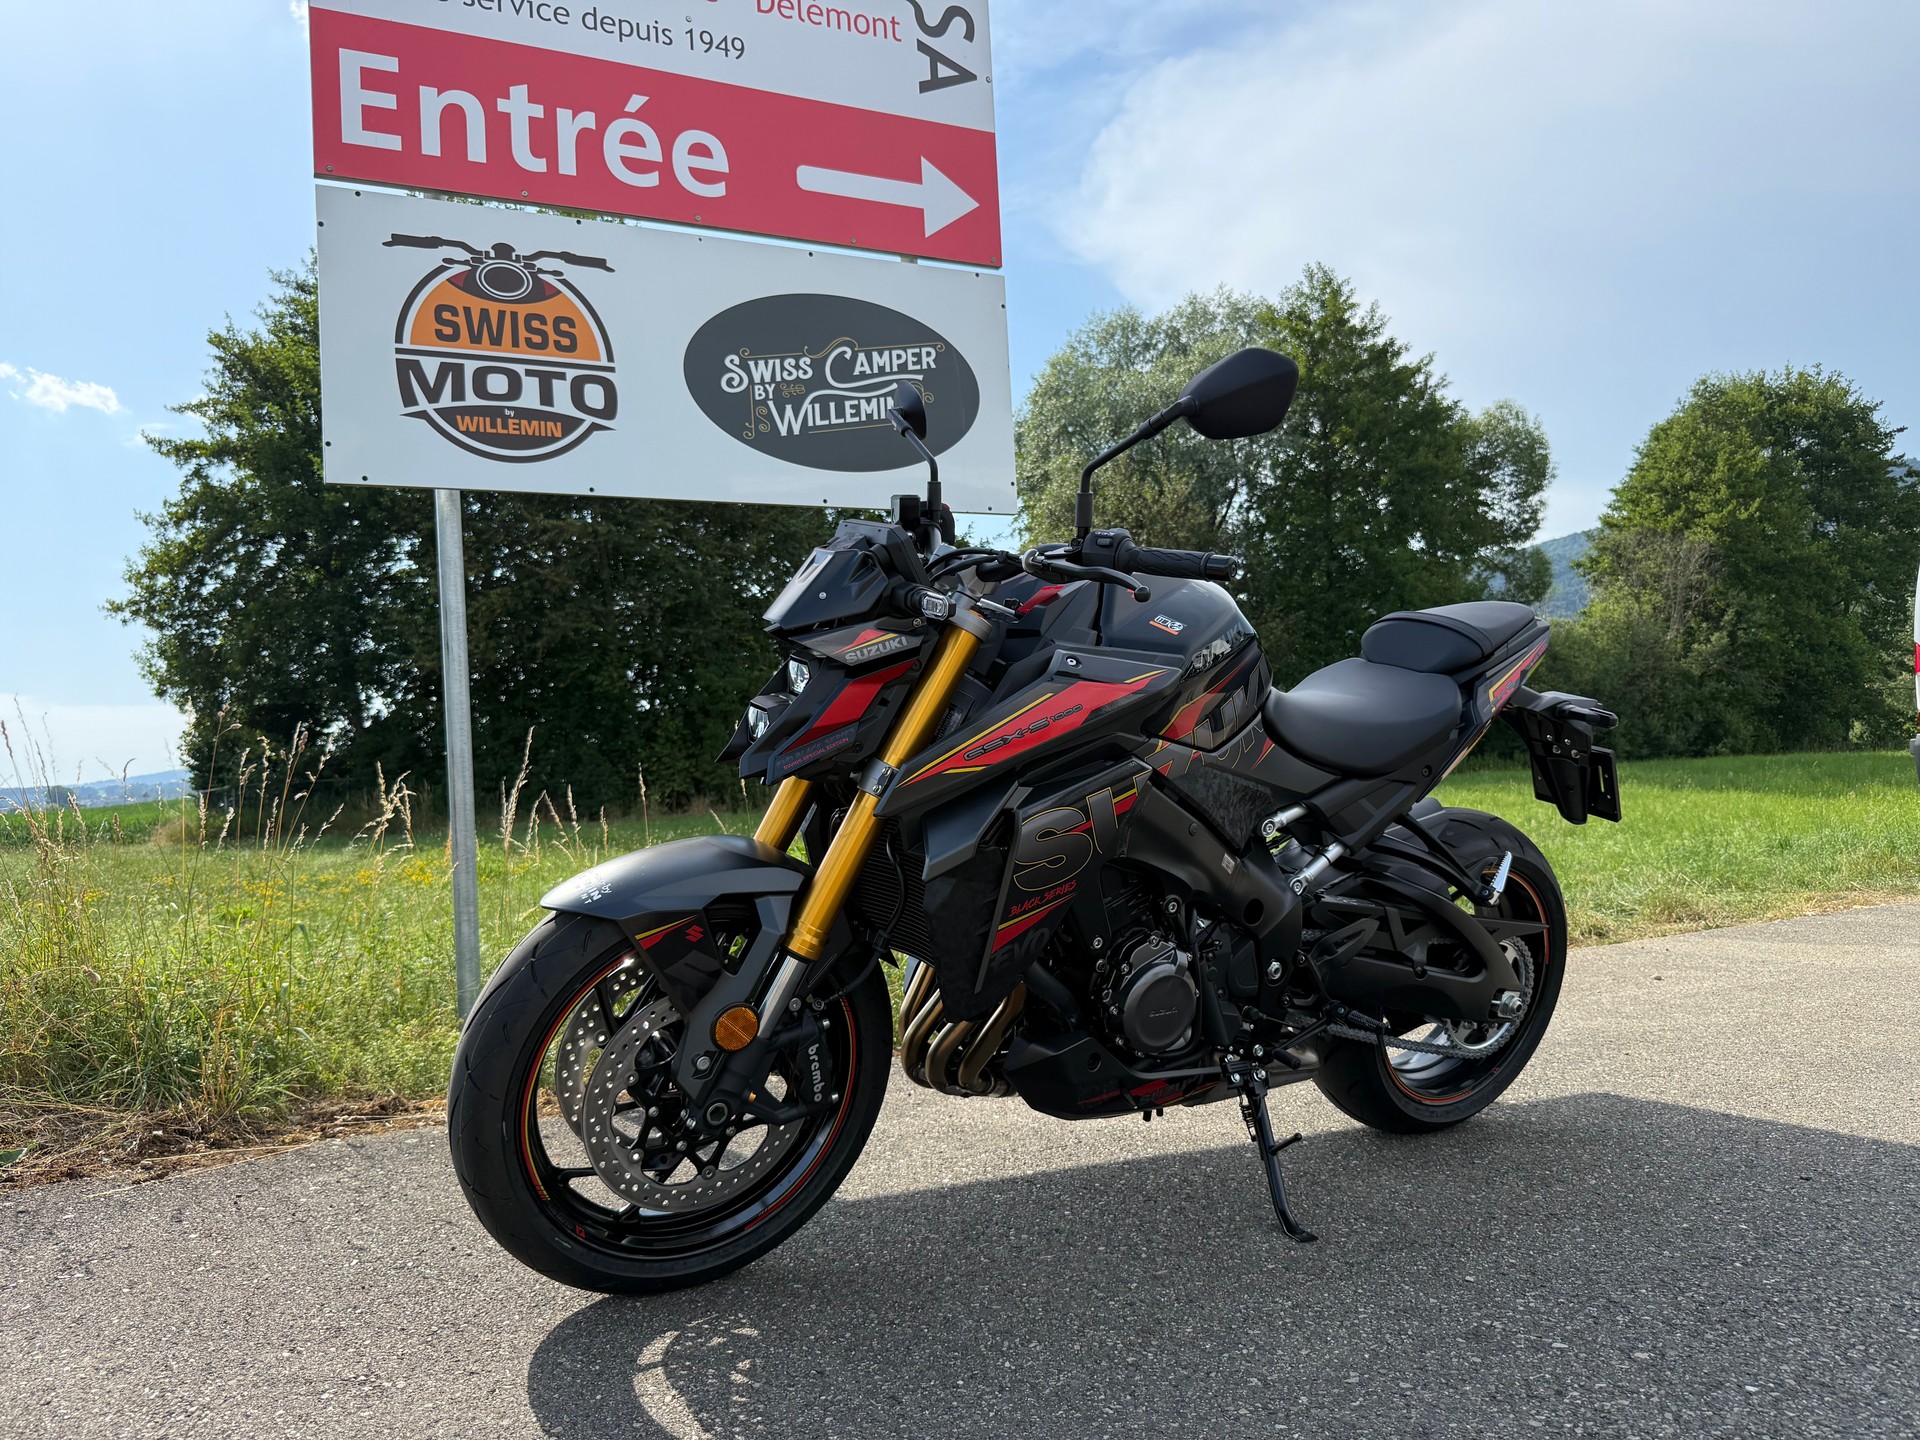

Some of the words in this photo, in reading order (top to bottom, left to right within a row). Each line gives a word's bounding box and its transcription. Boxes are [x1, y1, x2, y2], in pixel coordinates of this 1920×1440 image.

[581, 7, 673, 46] depuis
[685, 28, 745, 60] 1949
[338, 47, 730, 198] Entrée
[433, 303, 578, 354] SWISS
[395, 357, 619, 421] MOTO
[505, 408, 515, 418] by
[456, 415, 563, 438] WILLEMIN
[844, 636, 908, 663] SUZUKI
[963, 717, 1050, 761] GSX-S
[1050, 704, 1084, 722] 1000
[1009, 896, 1042, 917] BLACK
[1042, 879, 1077, 904] SERIES
[807, 1043, 826, 1103] brembo
